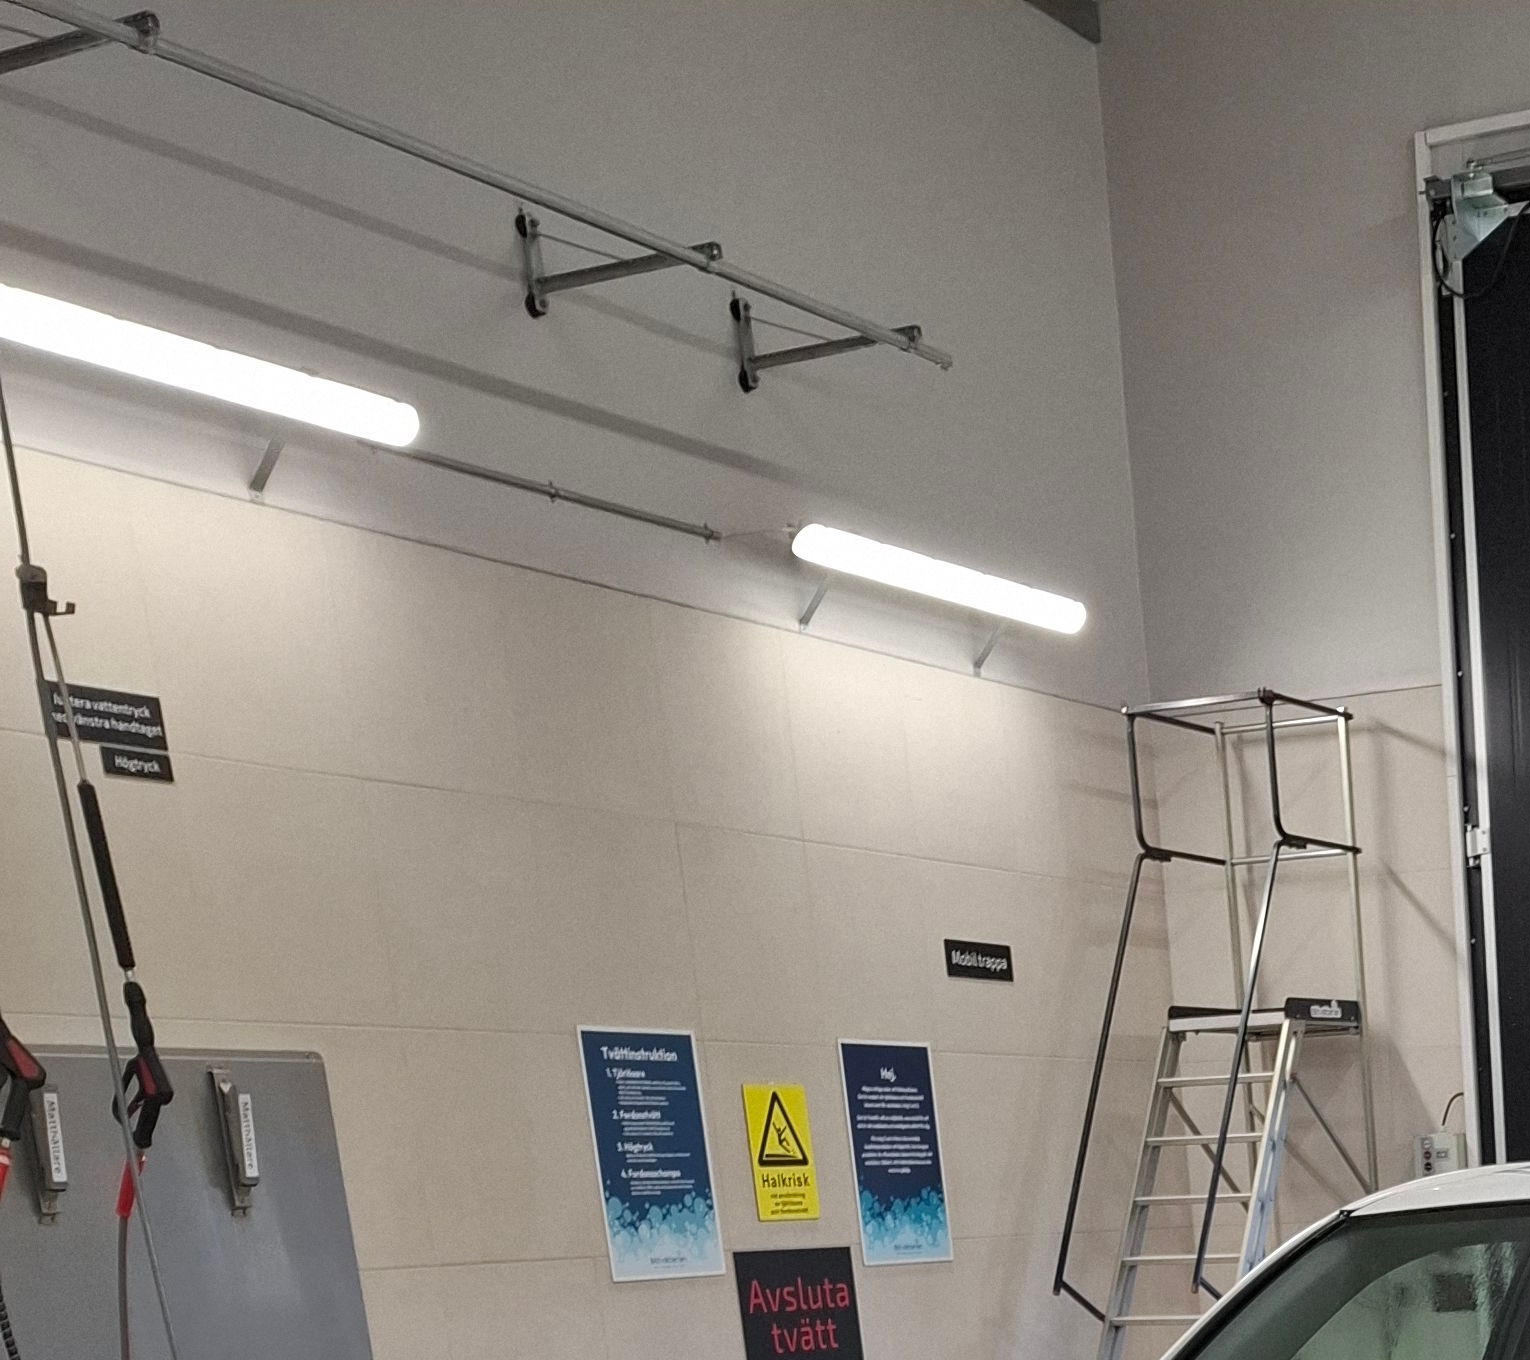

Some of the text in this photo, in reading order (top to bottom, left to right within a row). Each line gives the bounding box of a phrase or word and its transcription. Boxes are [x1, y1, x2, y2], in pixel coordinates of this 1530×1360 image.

[114, 754, 161, 773] Högtryck
[951, 950, 1008, 972] Mobil trappa
[600, 1046, 678, 1061] Tvättinstruktion
[762, 1172, 810, 1188] Halkrisk
[749, 1277, 850, 1314] Avsluta
[771, 1318, 839, 1354] tvätt
